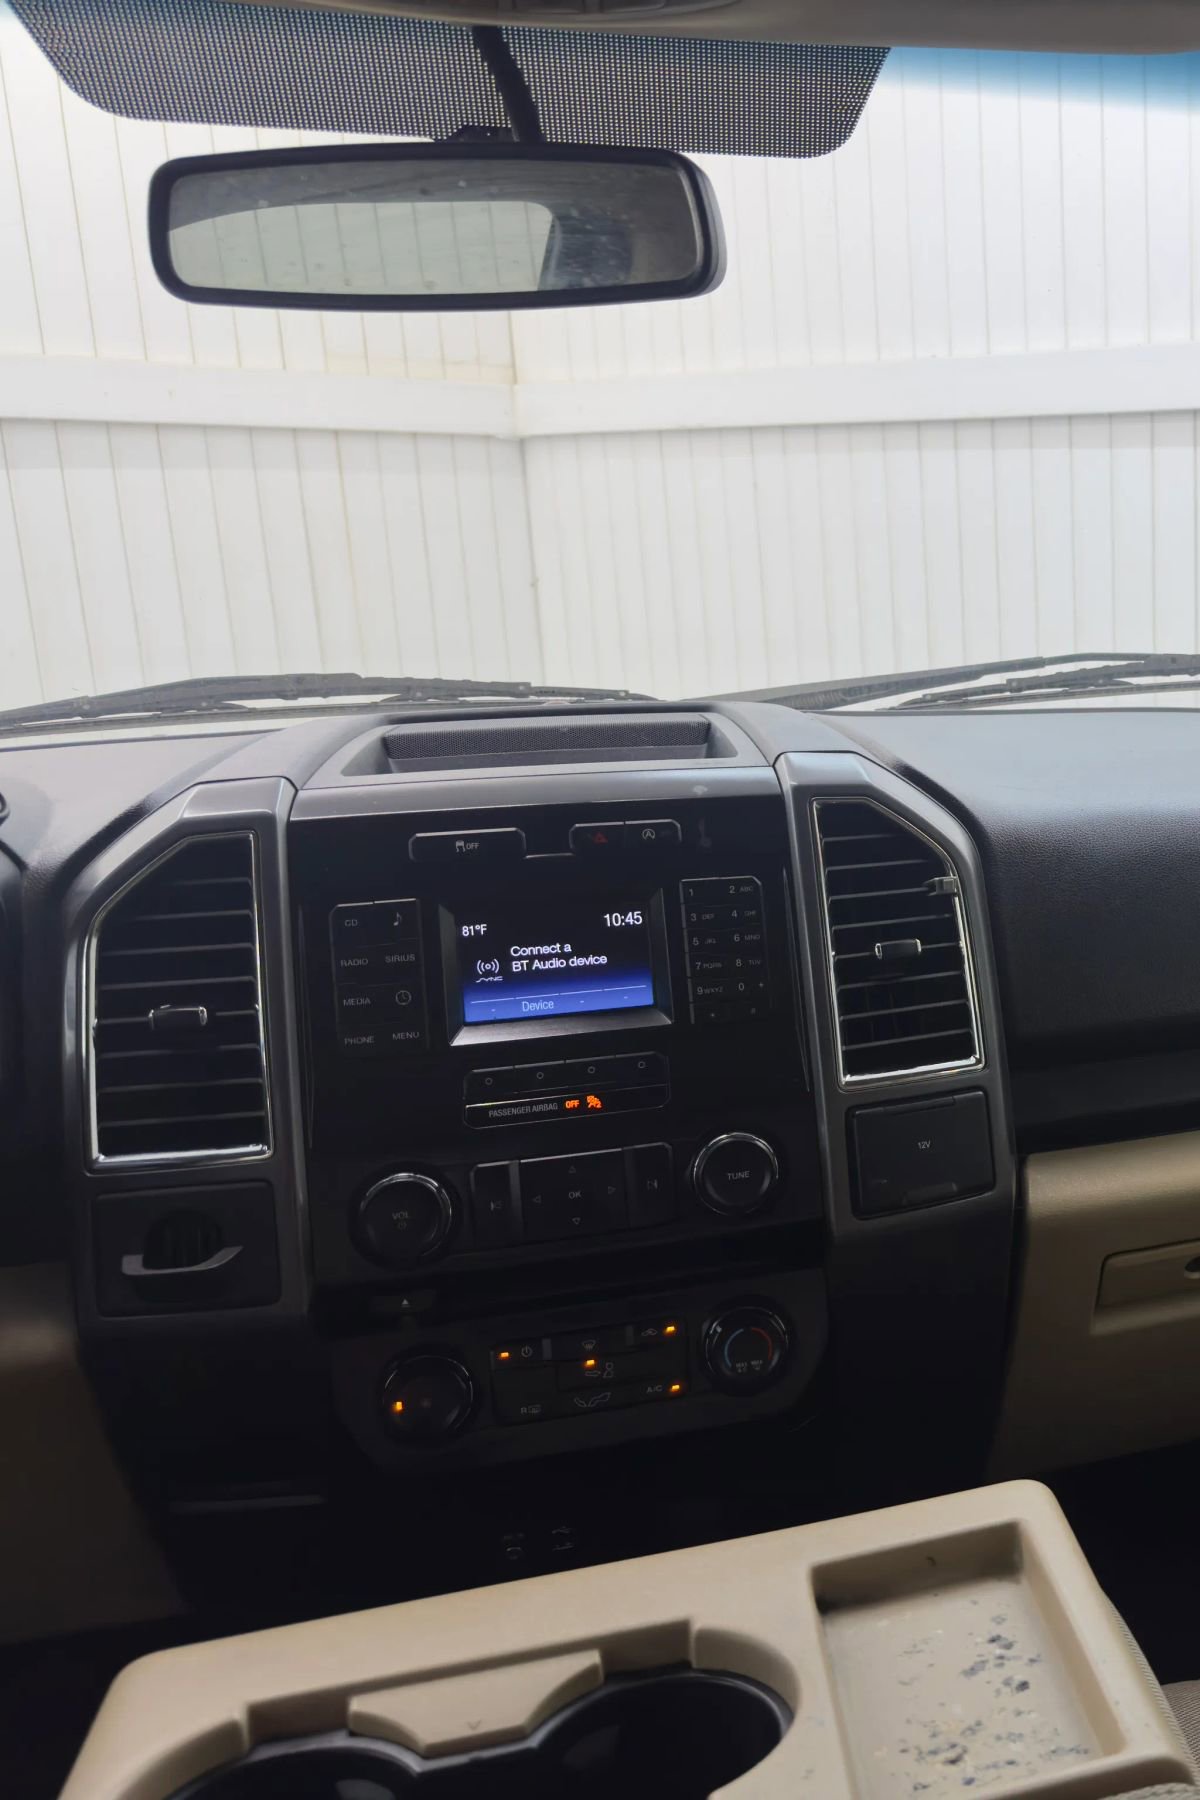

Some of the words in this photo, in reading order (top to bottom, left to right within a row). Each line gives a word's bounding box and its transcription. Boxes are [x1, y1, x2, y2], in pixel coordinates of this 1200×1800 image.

[466, 842, 480, 850] OFF
[689, 888, 694, 897] 1
[729, 885, 736, 894] 2
[690, 912, 697, 922] 3
[731, 909, 738, 918] 4
[604, 911, 643, 928] 10:45
[462, 924, 487, 937] 81°F
[692, 937, 699, 946] 5
[733, 933, 740, 942] 6
[510, 943, 561, 957] Connect
[564, 944, 572, 953] a
[340, 958, 369, 967] RADIO
[385, 954, 416, 963] SIRIUS
[512, 960, 529, 972] BT
[532, 957, 567, 971] Audio
[569, 954, 608, 968] device
[736, 958, 742, 967] 8
[697, 986, 703, 995] 9
[738, 982, 745, 991] 0
[343, 997, 371, 1006] MEDIA
[521, 1000, 555, 1012] Device
[344, 1036, 375, 1045] PHONE
[392, 1031, 420, 1041] MENU
[488, 1105, 531, 1118] PASSENGER
[531, 1102, 558, 1113] AIRBAG
[565, 1099, 580, 1109] OFF
[917, 1140, 931, 1149] 12V
[727, 1170, 750, 1181] TUNE
[568, 1190, 582, 1199] OK
